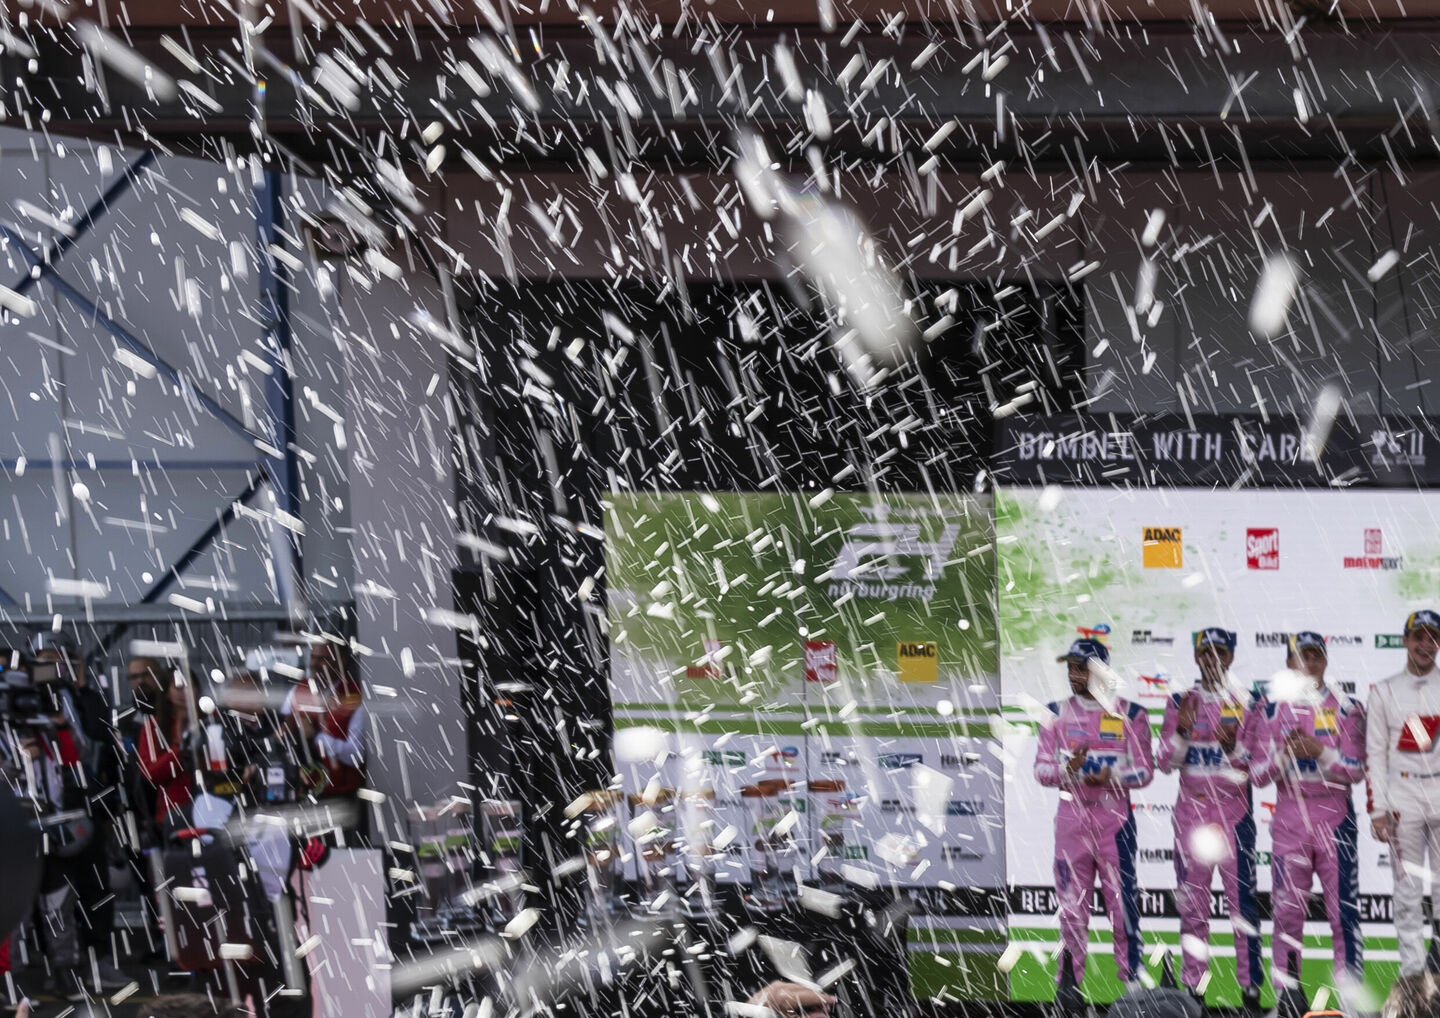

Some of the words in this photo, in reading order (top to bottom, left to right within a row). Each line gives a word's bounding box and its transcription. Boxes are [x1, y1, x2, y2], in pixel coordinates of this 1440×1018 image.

[1019, 432, 1134, 461] BEMBEL
[1153, 432, 1222, 460] WITH
[1143, 528, 1182, 542] ADAC
[900, 643, 935, 658] ADAC
[1186, 746, 1223, 767] BW
